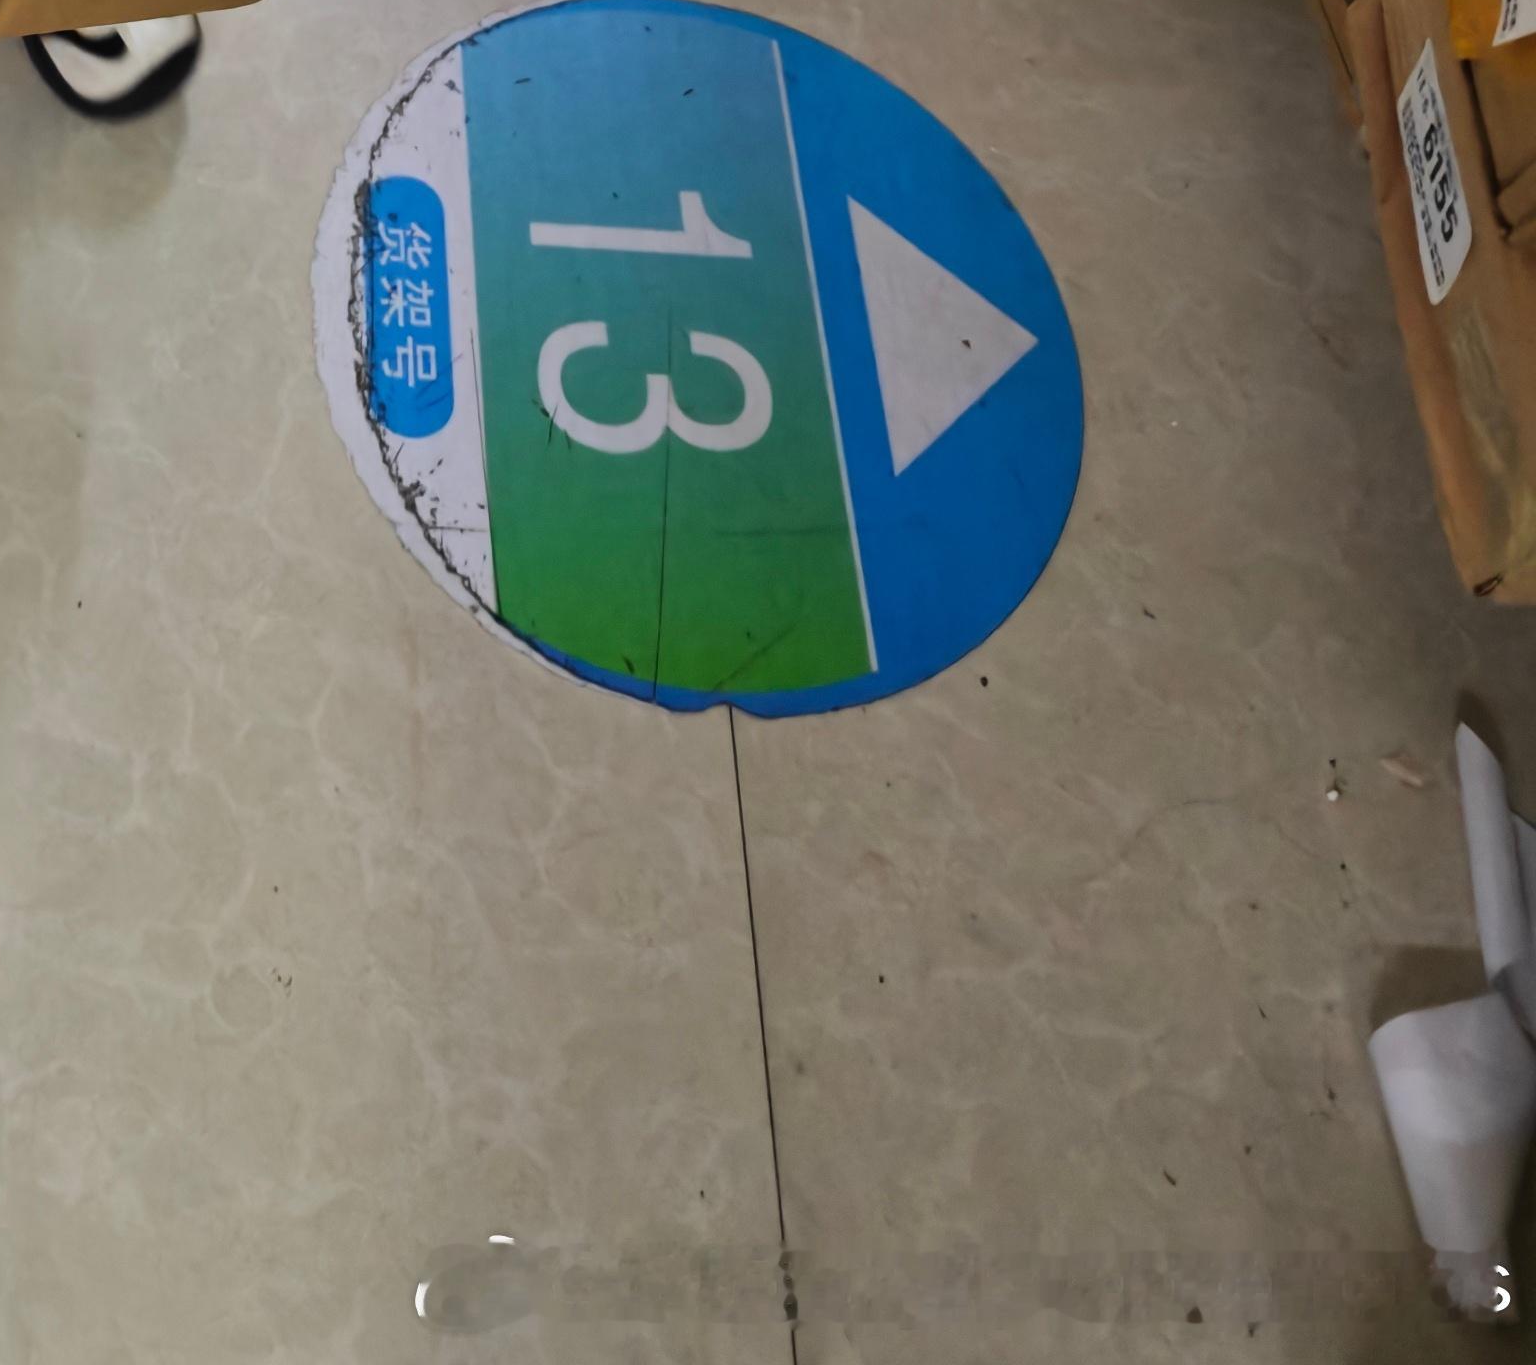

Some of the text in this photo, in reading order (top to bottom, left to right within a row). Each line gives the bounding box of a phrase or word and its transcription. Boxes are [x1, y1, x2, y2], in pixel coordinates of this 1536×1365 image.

[1423, 122, 1459, 244] 6155
[376, 219, 438, 387] 货架号
[529, 190, 773, 454] 13
